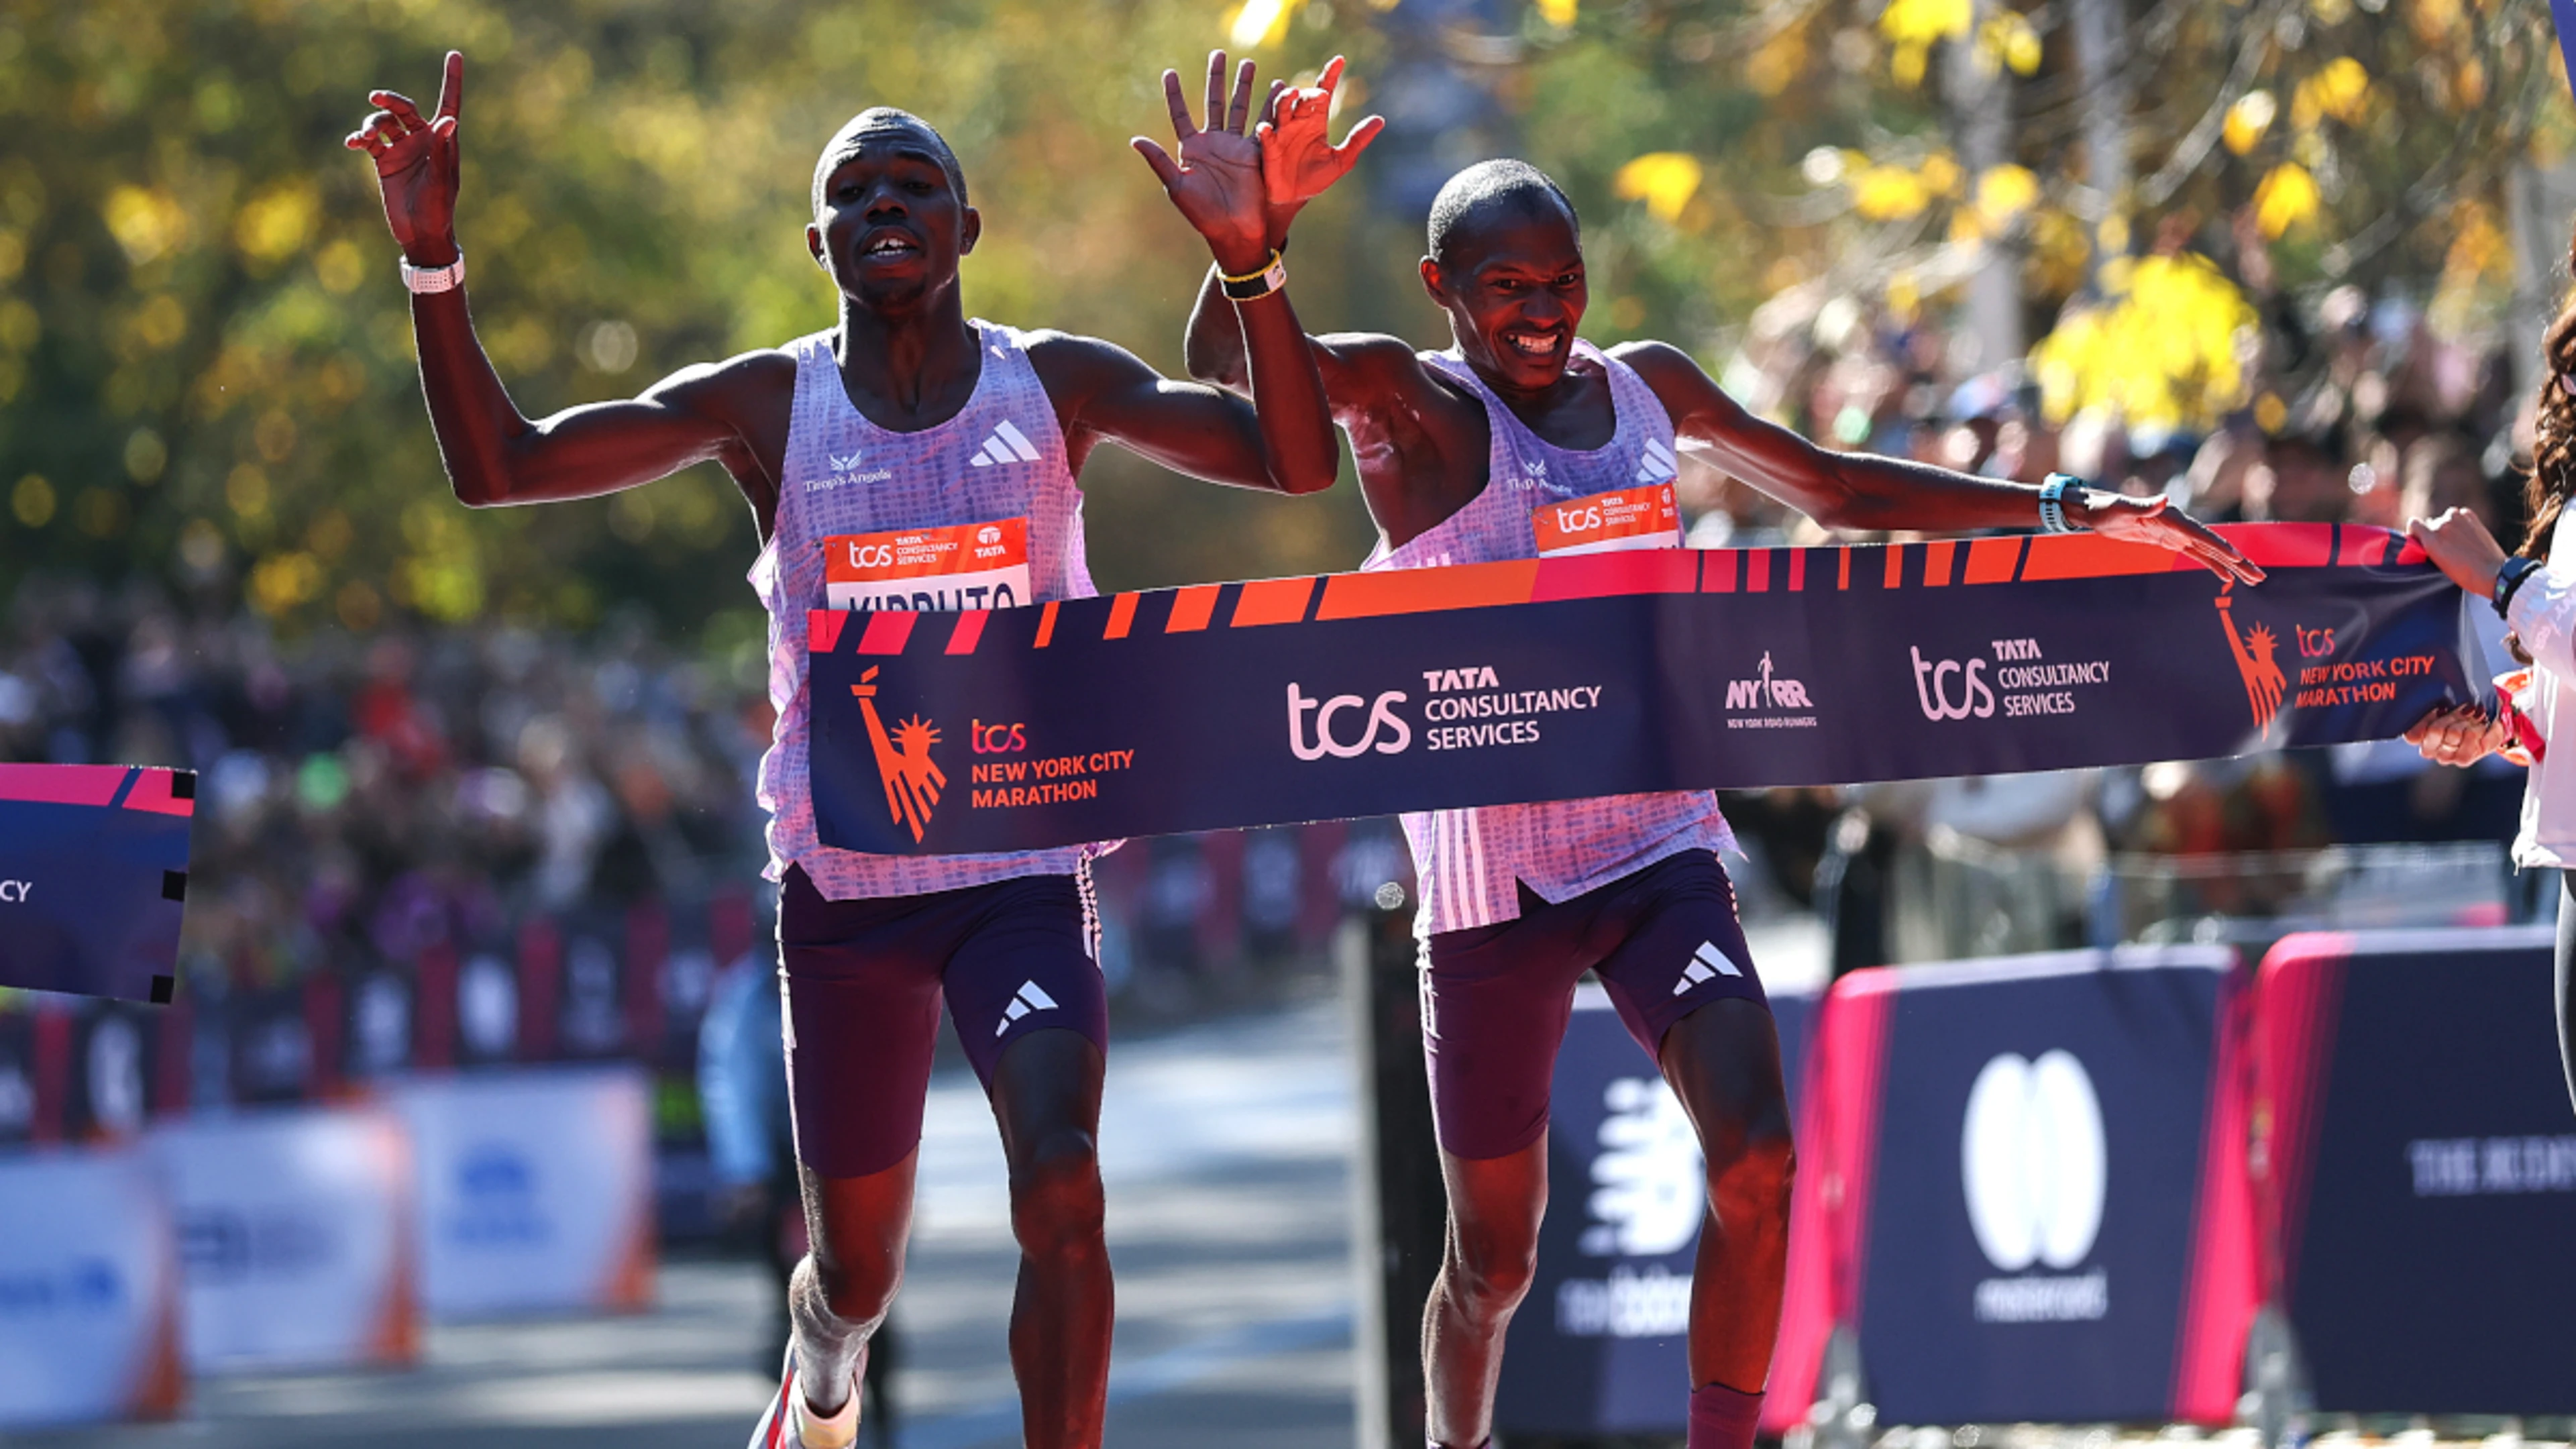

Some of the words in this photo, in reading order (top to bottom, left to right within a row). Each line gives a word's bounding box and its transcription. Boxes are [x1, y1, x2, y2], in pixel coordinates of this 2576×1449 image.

[1556, 506, 1602, 533] tcs
[849, 541, 893, 568] tcs
[974, 545, 1006, 558] TATA
[1992, 638, 2042, 661] TATA
[2296, 623, 2336, 657] tcs
[1423, 666, 1499, 692] TATA
[1910, 645, 1995, 722] tcs
[1998, 661, 2110, 689] CONSULTANCY
[2300, 664, 2332, 686] NEW
[2332, 659, 2387, 682] YORK
[2390, 655, 2435, 676] CITY
[1424, 686, 1602, 721] CONSULTANCY
[1725, 680, 1814, 709] NYRR
[2003, 691, 2076, 716] SERVICES
[2294, 682, 2397, 708] MARATHON
[972, 718, 1027, 754] tcs
[1287, 682, 1411, 761] tcs
[1427, 720, 1540, 751] SERVICES
[972, 761, 1027, 784] NEW
[1032, 755, 1087, 780] YORK
[1089, 749, 1134, 772] CITY
[972, 779, 1097, 808] MARATHON
